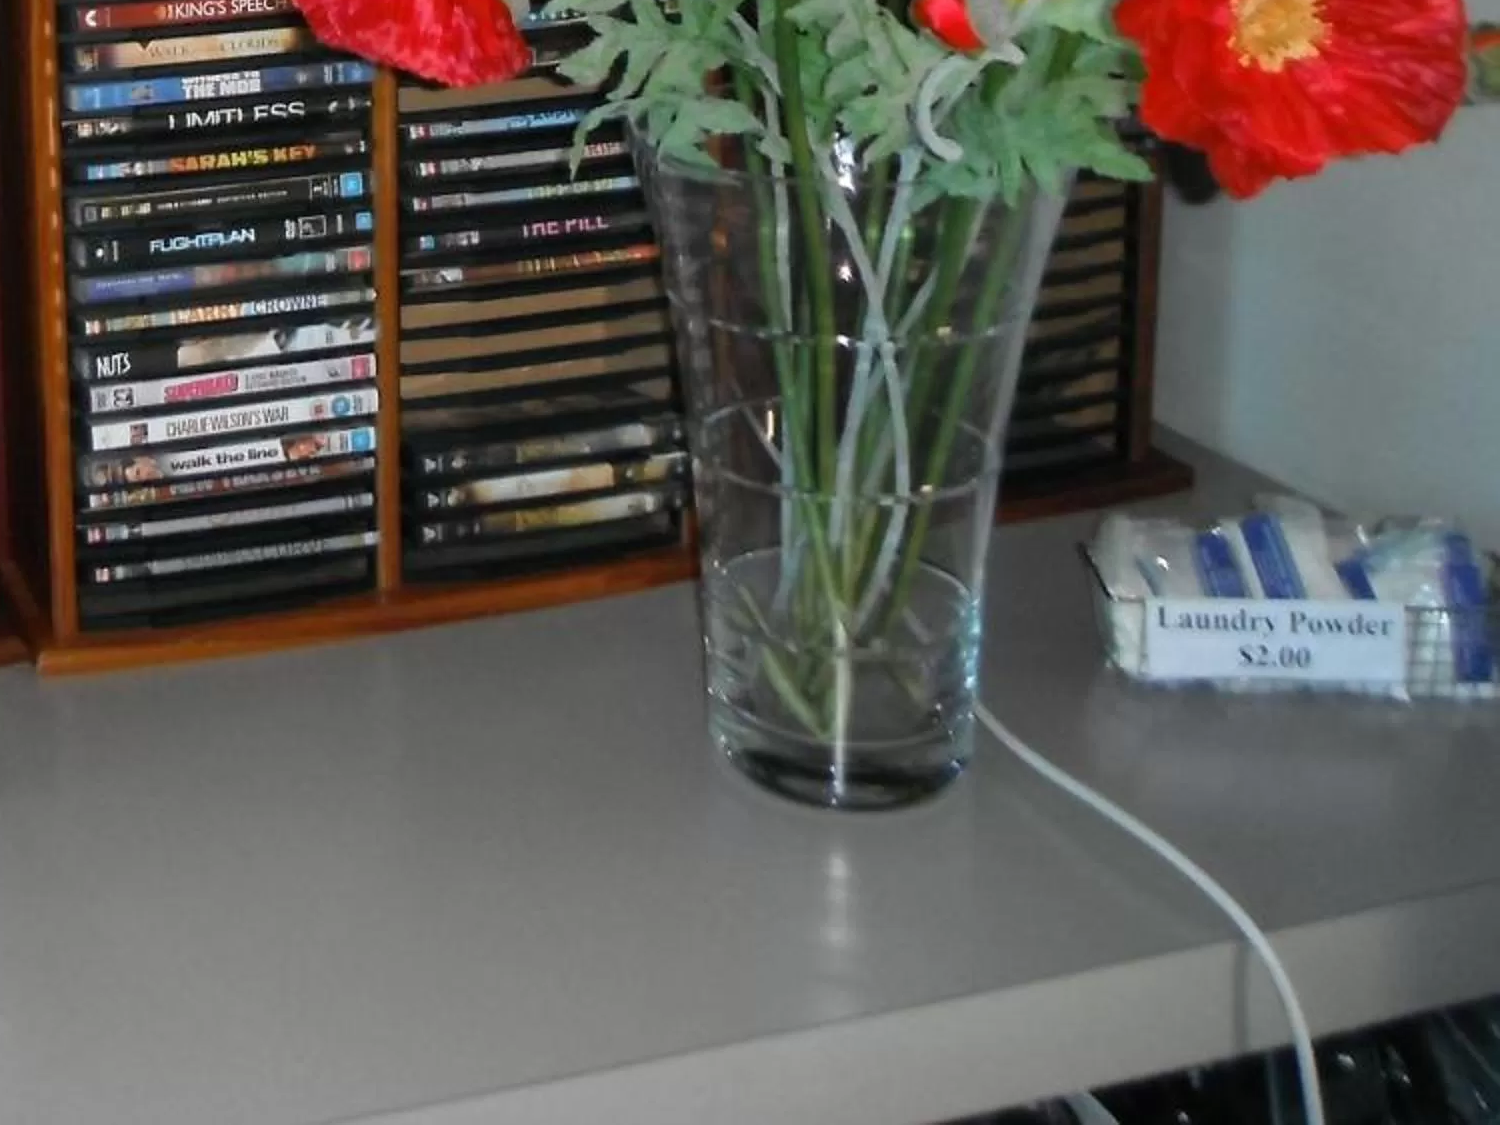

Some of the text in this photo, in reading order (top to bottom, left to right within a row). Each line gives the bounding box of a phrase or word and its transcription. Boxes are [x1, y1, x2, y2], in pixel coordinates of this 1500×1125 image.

[169, 149, 268, 173] SARAH'S
[151, 228, 256, 253] FLIGHTPLAN
[97, 352, 131, 378] NUTS
[263, 405, 289, 423] WAR
[171, 445, 279, 471] walk the line
[1158, 606, 1395, 638] Laundry Powder
[1238, 644, 1314, 669] $2.00
